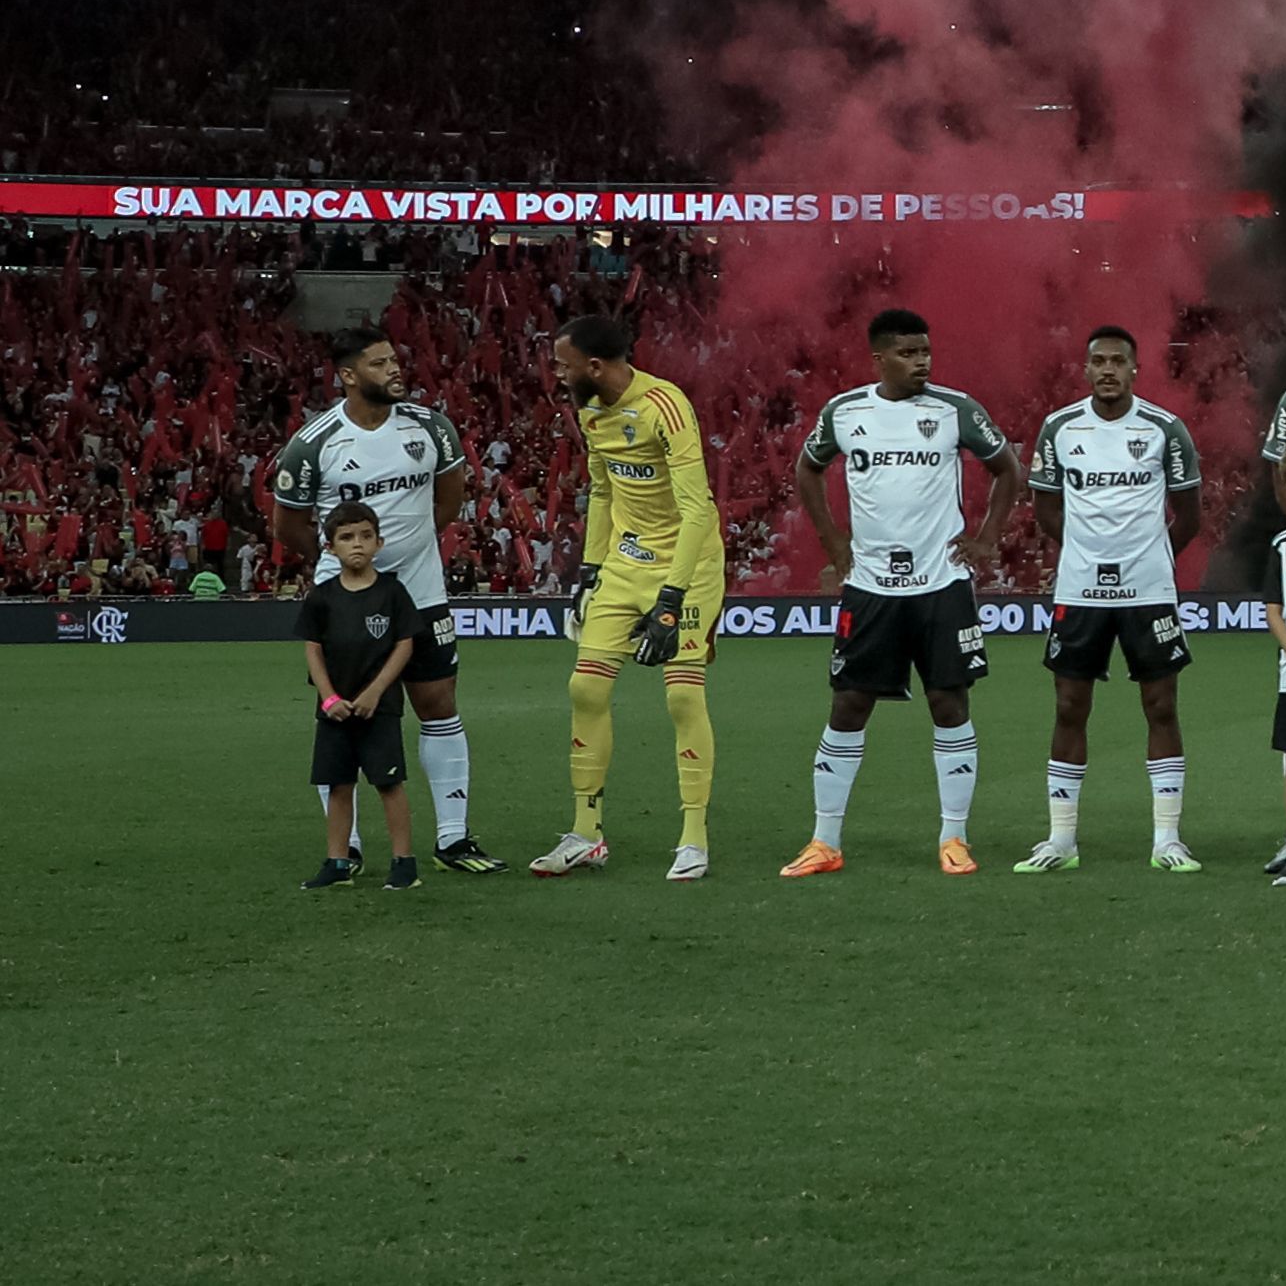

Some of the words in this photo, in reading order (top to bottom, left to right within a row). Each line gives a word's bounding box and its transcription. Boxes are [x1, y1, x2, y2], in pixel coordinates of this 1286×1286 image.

[114, 186, 203, 216] SUA
[214, 188, 372, 218] MARCA
[382, 191, 506, 220] VISTA
[614, 193, 818, 222] MILHARES
[831, 194, 883, 221] DE
[872, 450, 941, 467] BETANO
[364, 471, 430, 498] BETANO
[1085, 470, 1152, 487] BETANO
[875, 575, 929, 588] GERDAU
[1082, 588, 1137, 600] GERDAU
[979, 604, 1024, 633] 90
